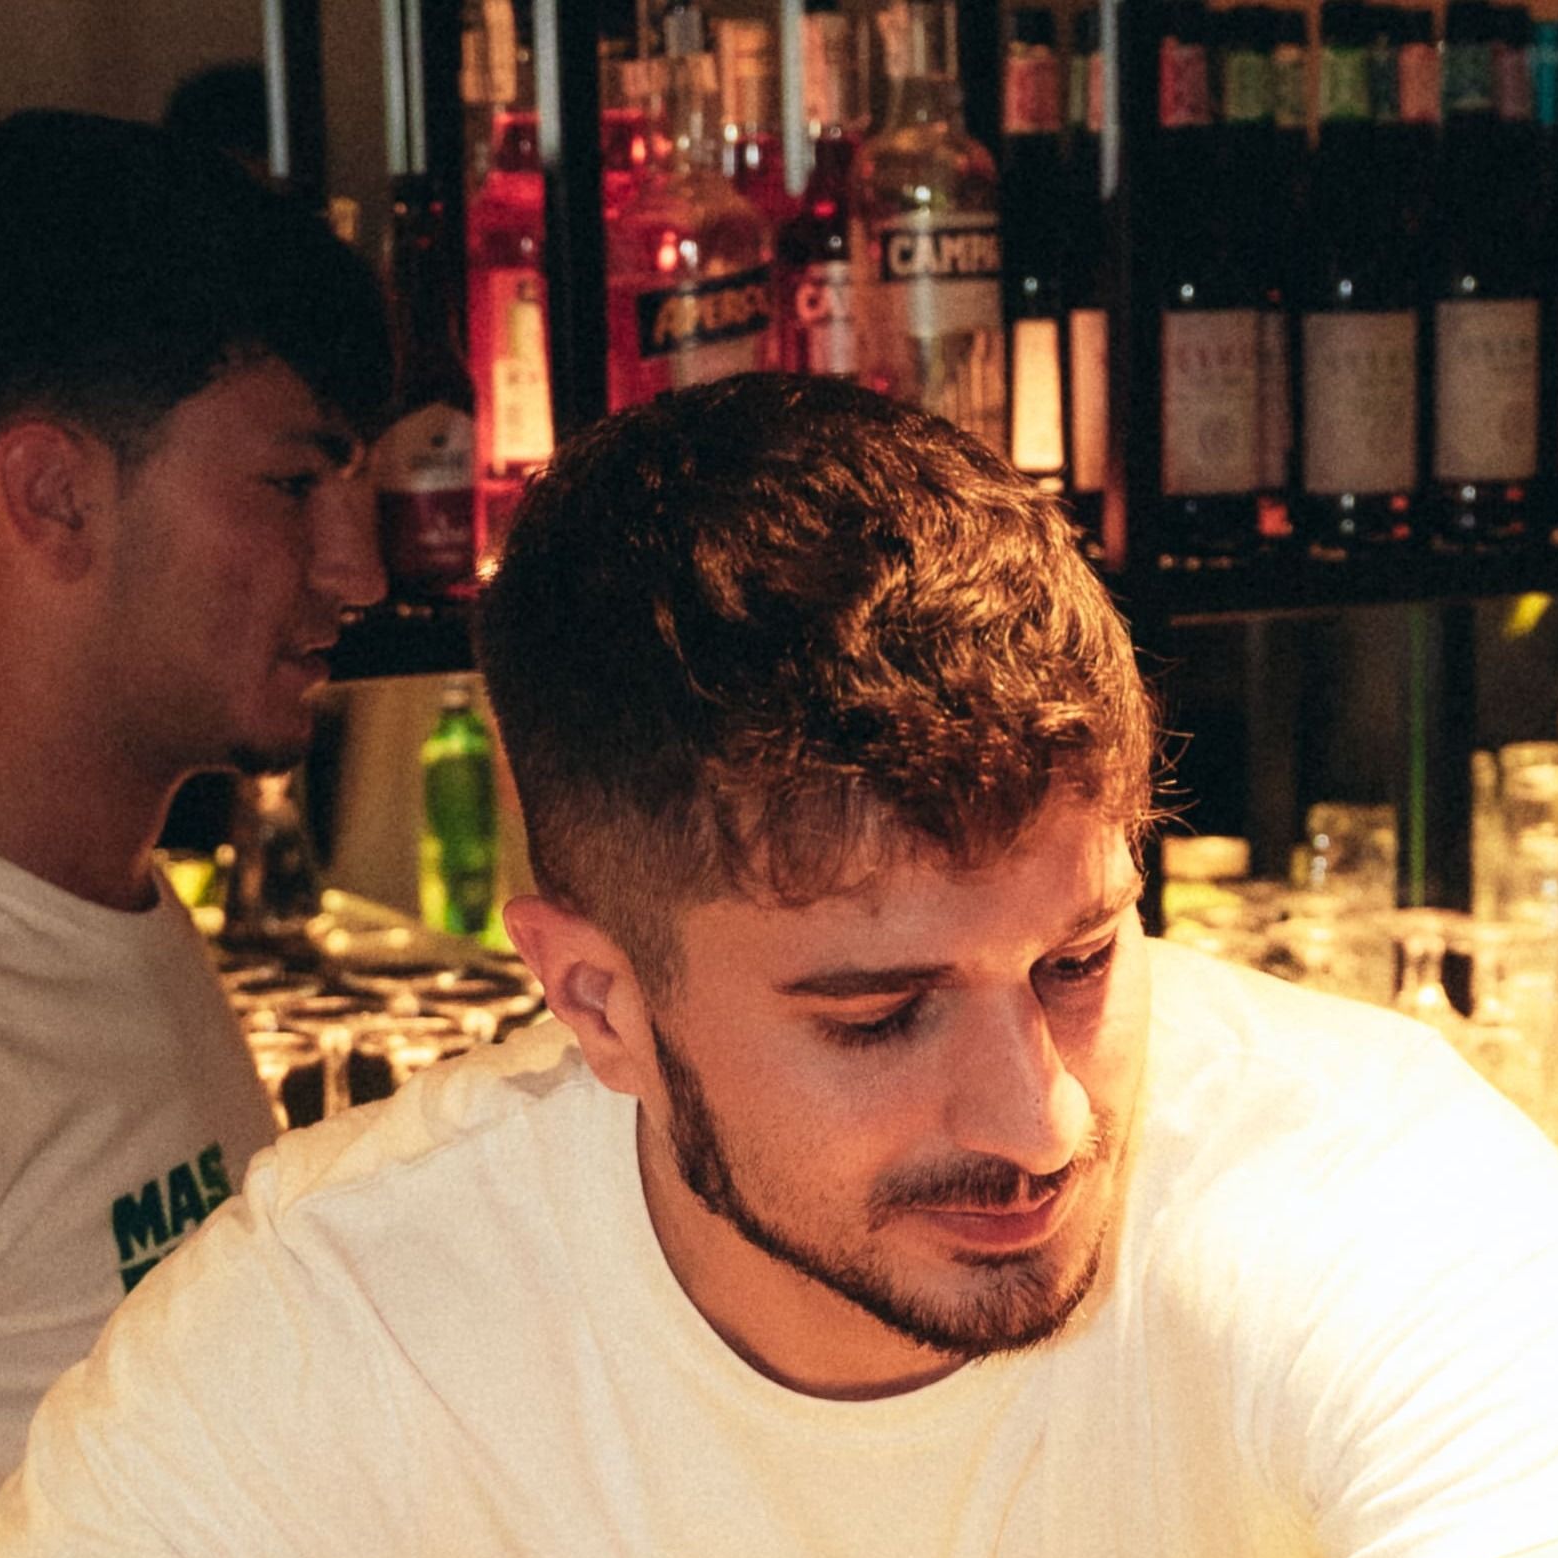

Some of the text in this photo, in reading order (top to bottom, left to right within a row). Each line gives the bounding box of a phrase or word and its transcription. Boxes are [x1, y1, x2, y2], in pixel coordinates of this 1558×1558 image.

[889, 233, 999, 275] CAMIN
[653, 283, 767, 344] APERO
[112, 1141, 233, 1262] MAS
